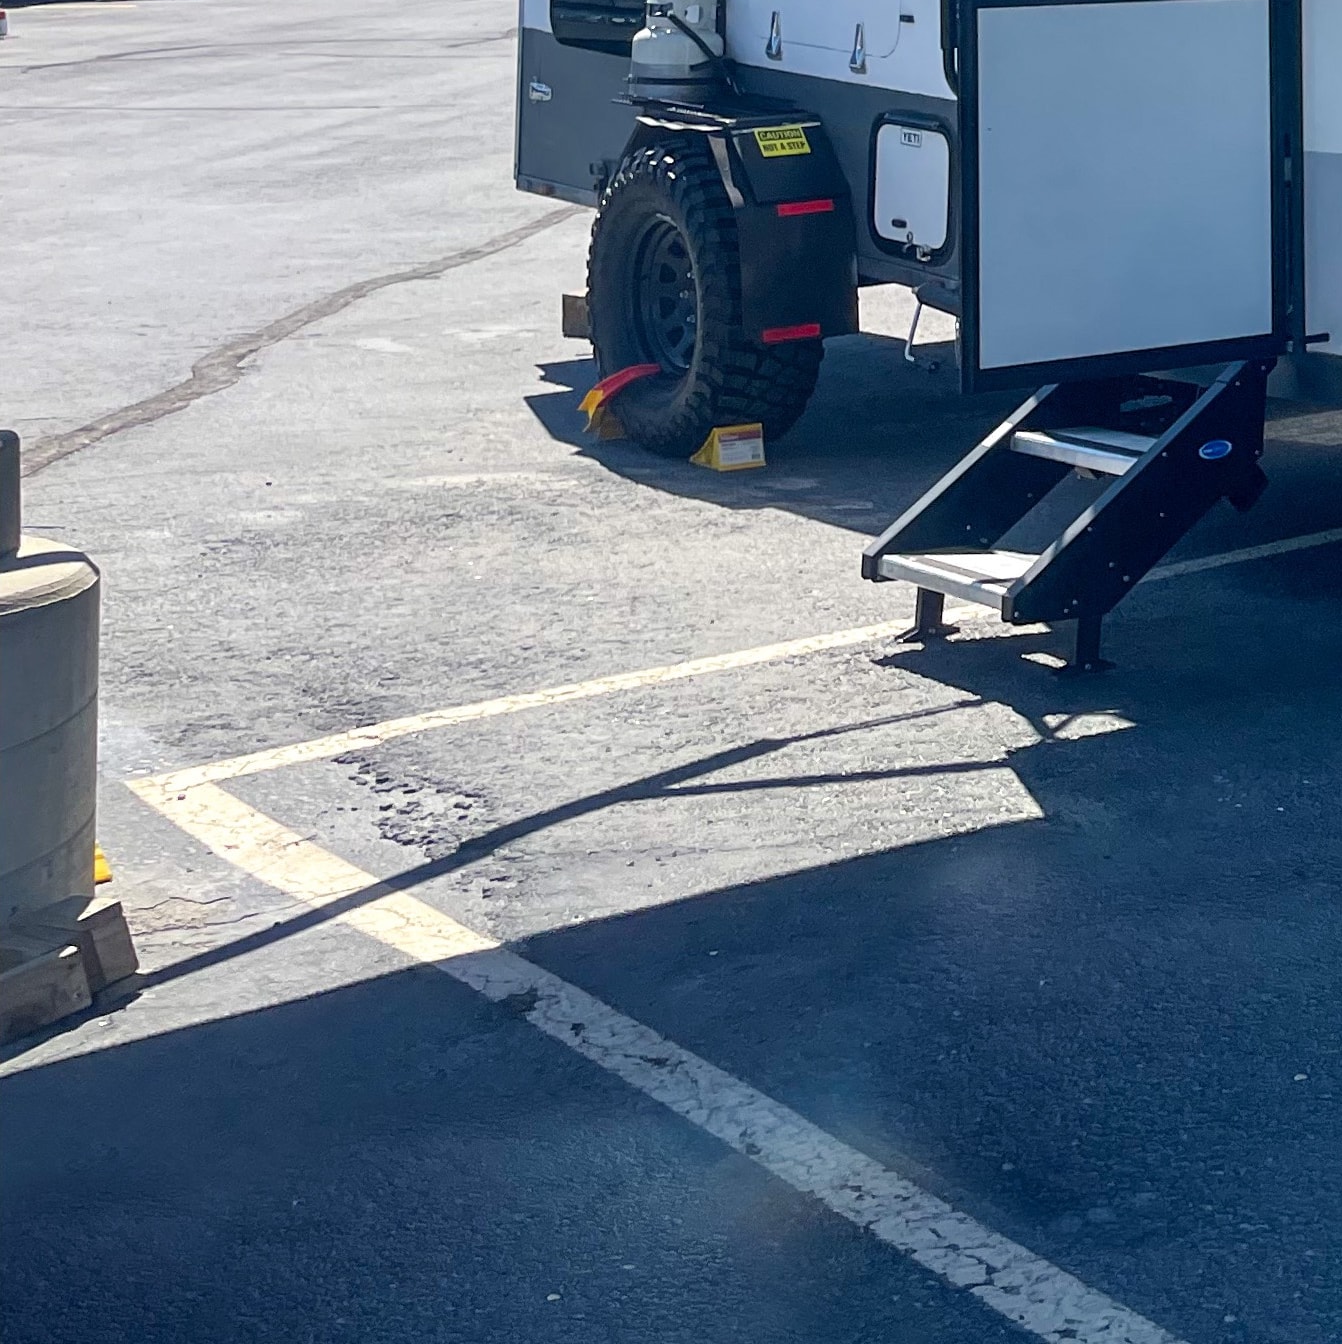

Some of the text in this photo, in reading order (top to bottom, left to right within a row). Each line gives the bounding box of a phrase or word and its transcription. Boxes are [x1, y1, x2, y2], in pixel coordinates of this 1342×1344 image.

[759, 128, 801, 141] CAUTION
[902, 132, 920, 144] YETI
[762, 141, 806, 152] NOT A STEP
